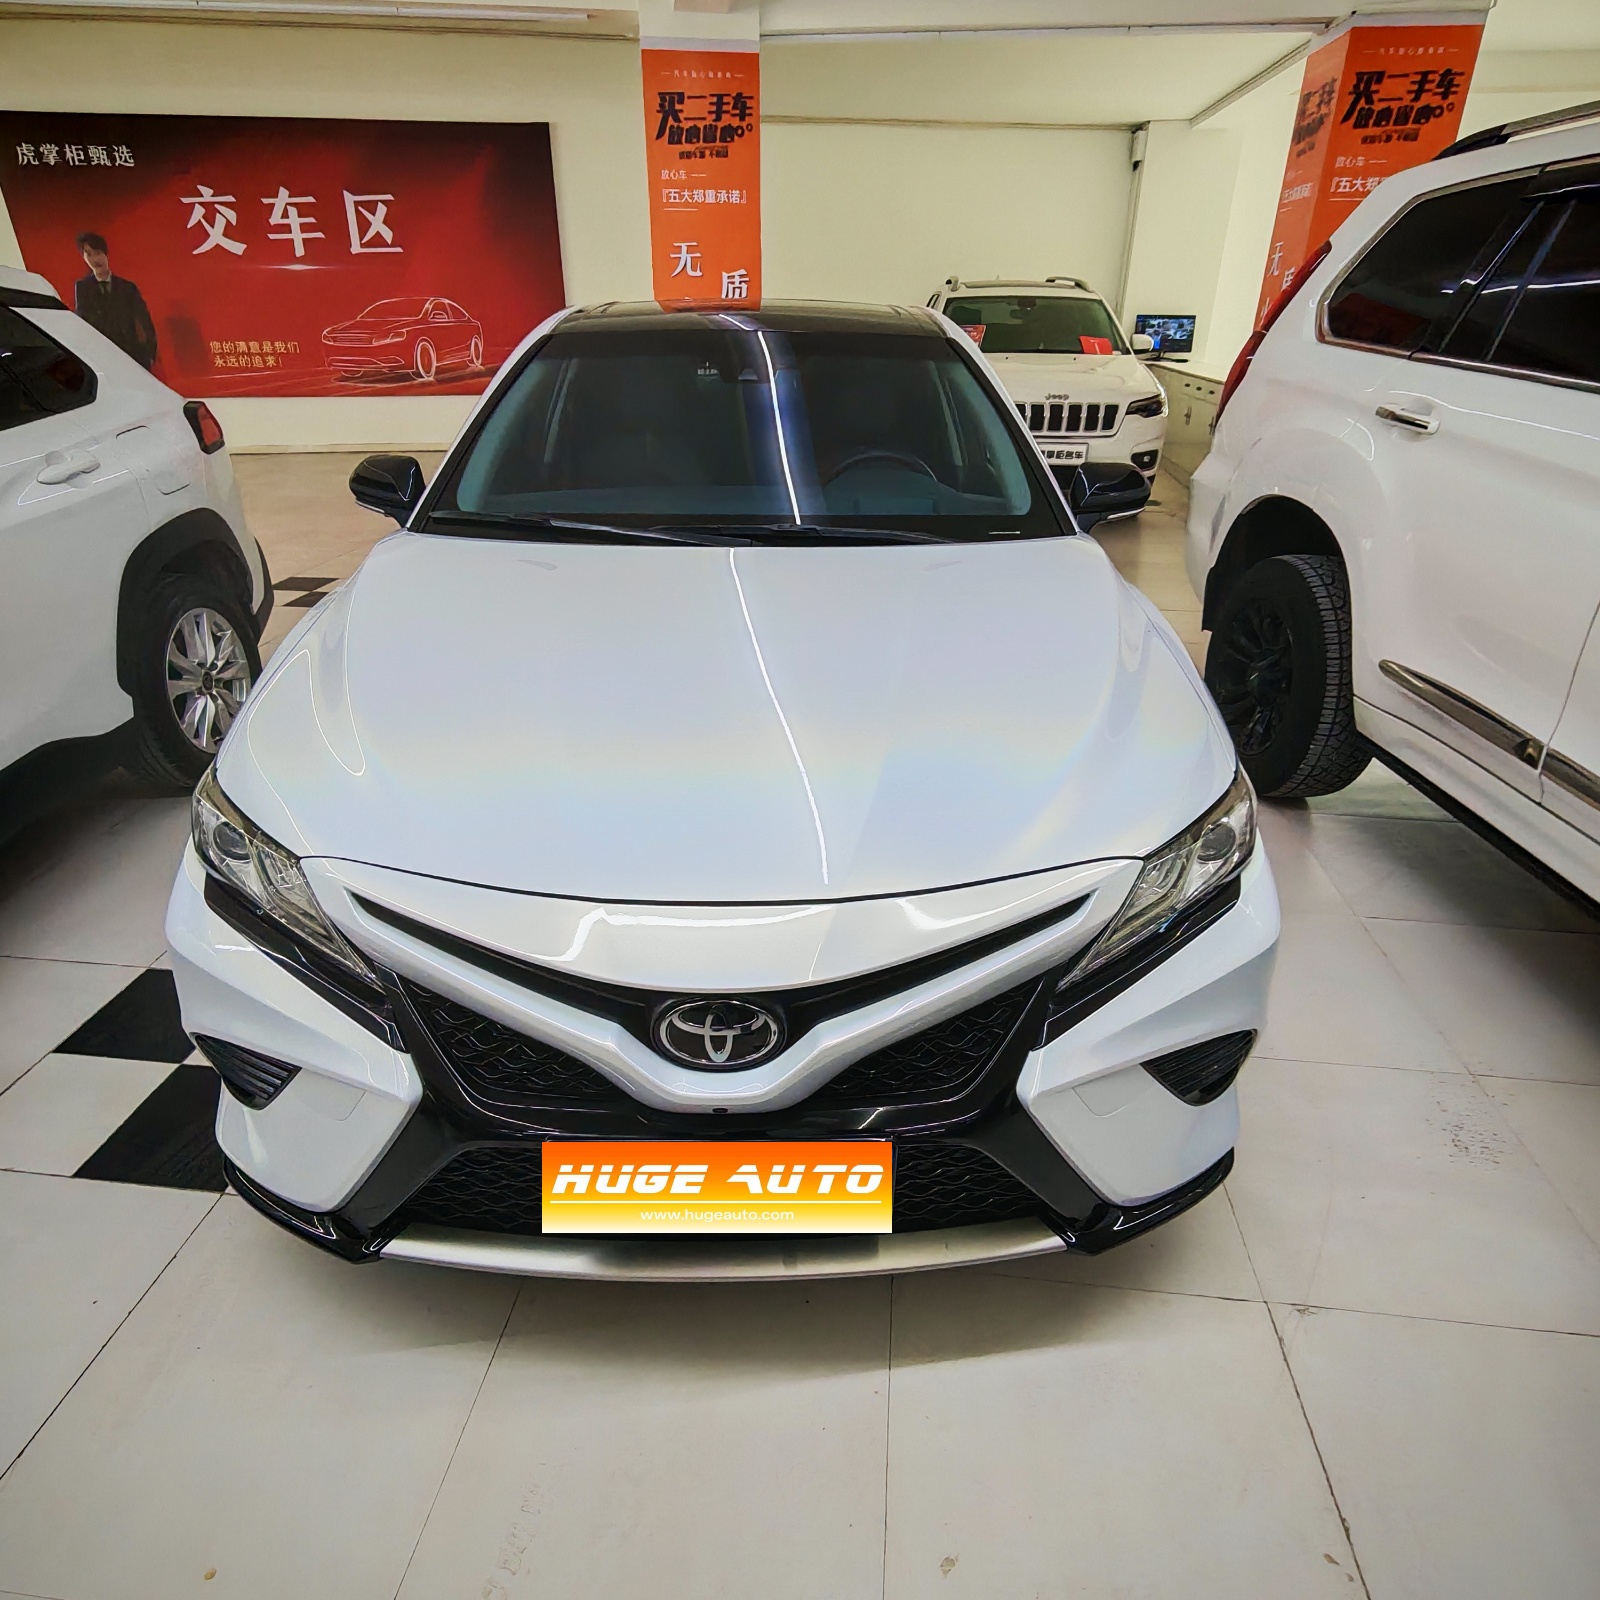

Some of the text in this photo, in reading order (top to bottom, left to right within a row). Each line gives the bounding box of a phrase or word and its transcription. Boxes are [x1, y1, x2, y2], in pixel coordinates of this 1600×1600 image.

[1341, 69, 1465, 124] 买二手车
[656, 91, 754, 140] 买二手车
[16, 142, 135, 167] 虎掌柜甄选
[661, 169, 688, 180] 放心车
[662, 188, 748, 204] 『五大郑重承诺』
[180, 185, 404, 257] 交车区
[669, 241, 703, 278] 无
[209, 340, 300, 354] 您的满意是我们
[1044, 393, 1070, 401] Jeep
